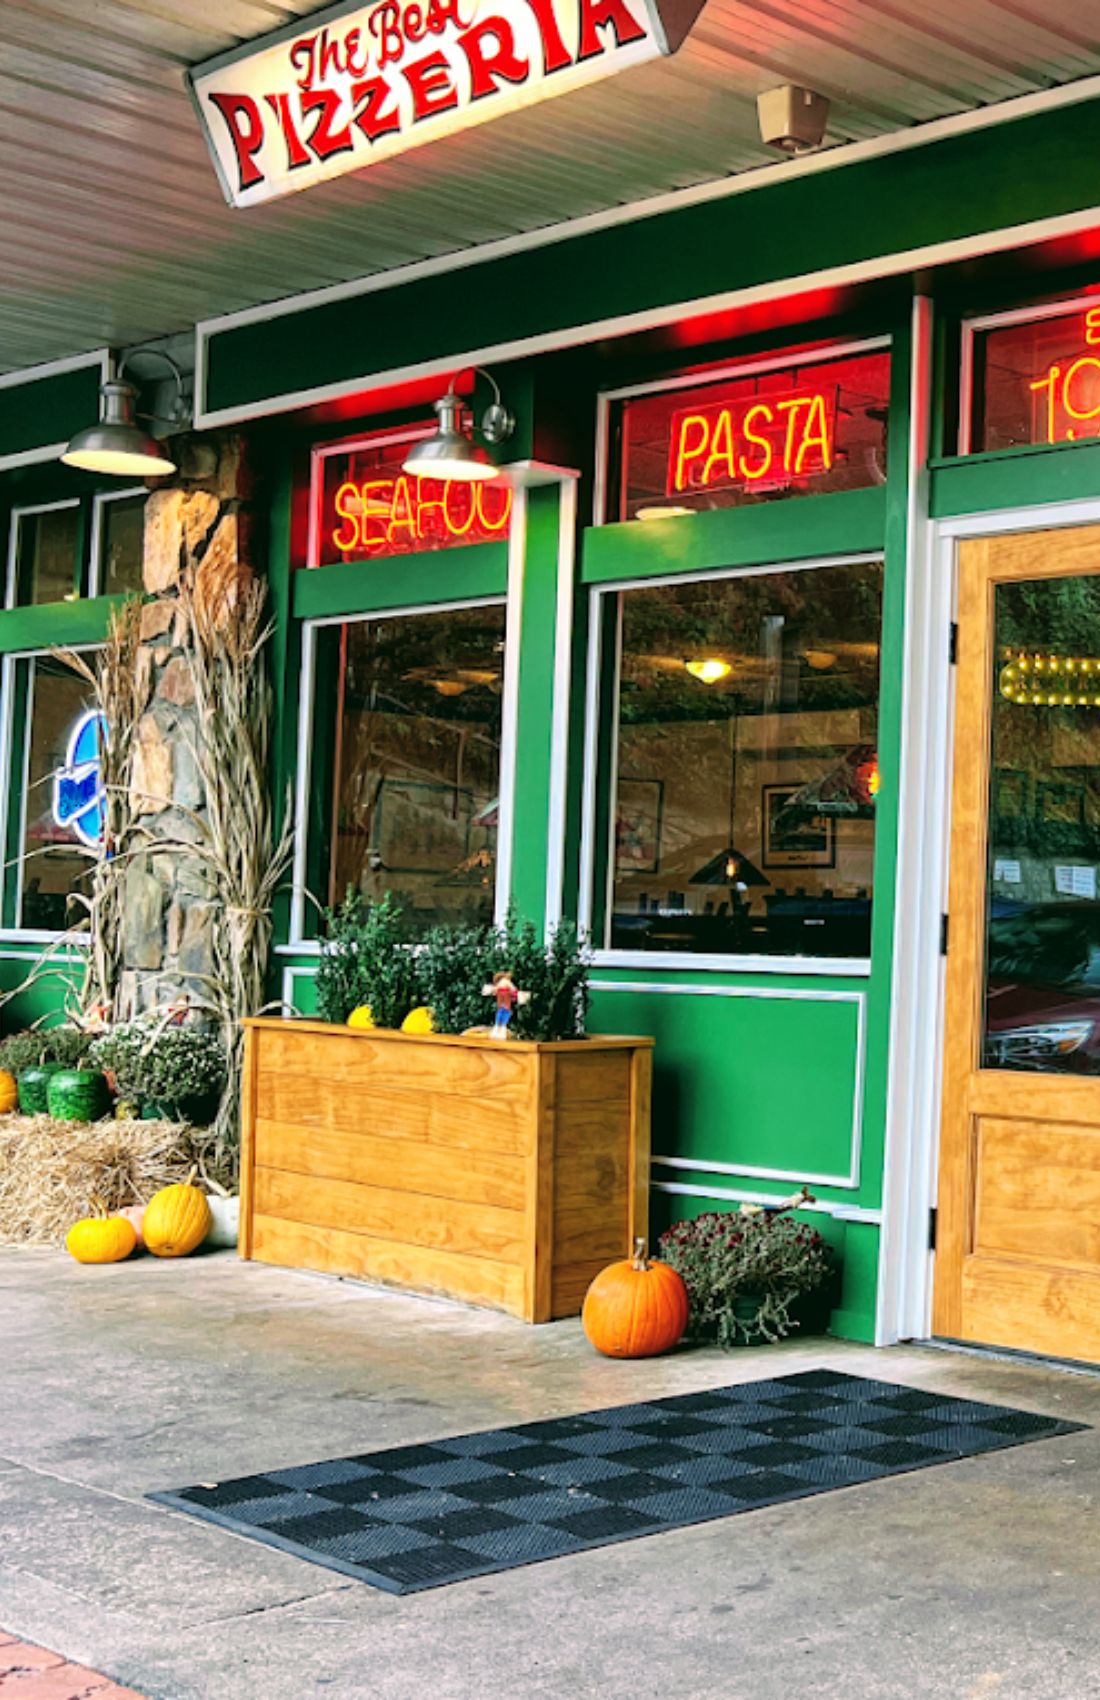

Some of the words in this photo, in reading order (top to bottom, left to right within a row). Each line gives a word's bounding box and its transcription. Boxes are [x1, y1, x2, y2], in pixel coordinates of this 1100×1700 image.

[209, 0, 647, 191] PIZZERIA
[290, 28, 369, 91] The
[675, 394, 832, 490] PASTA
